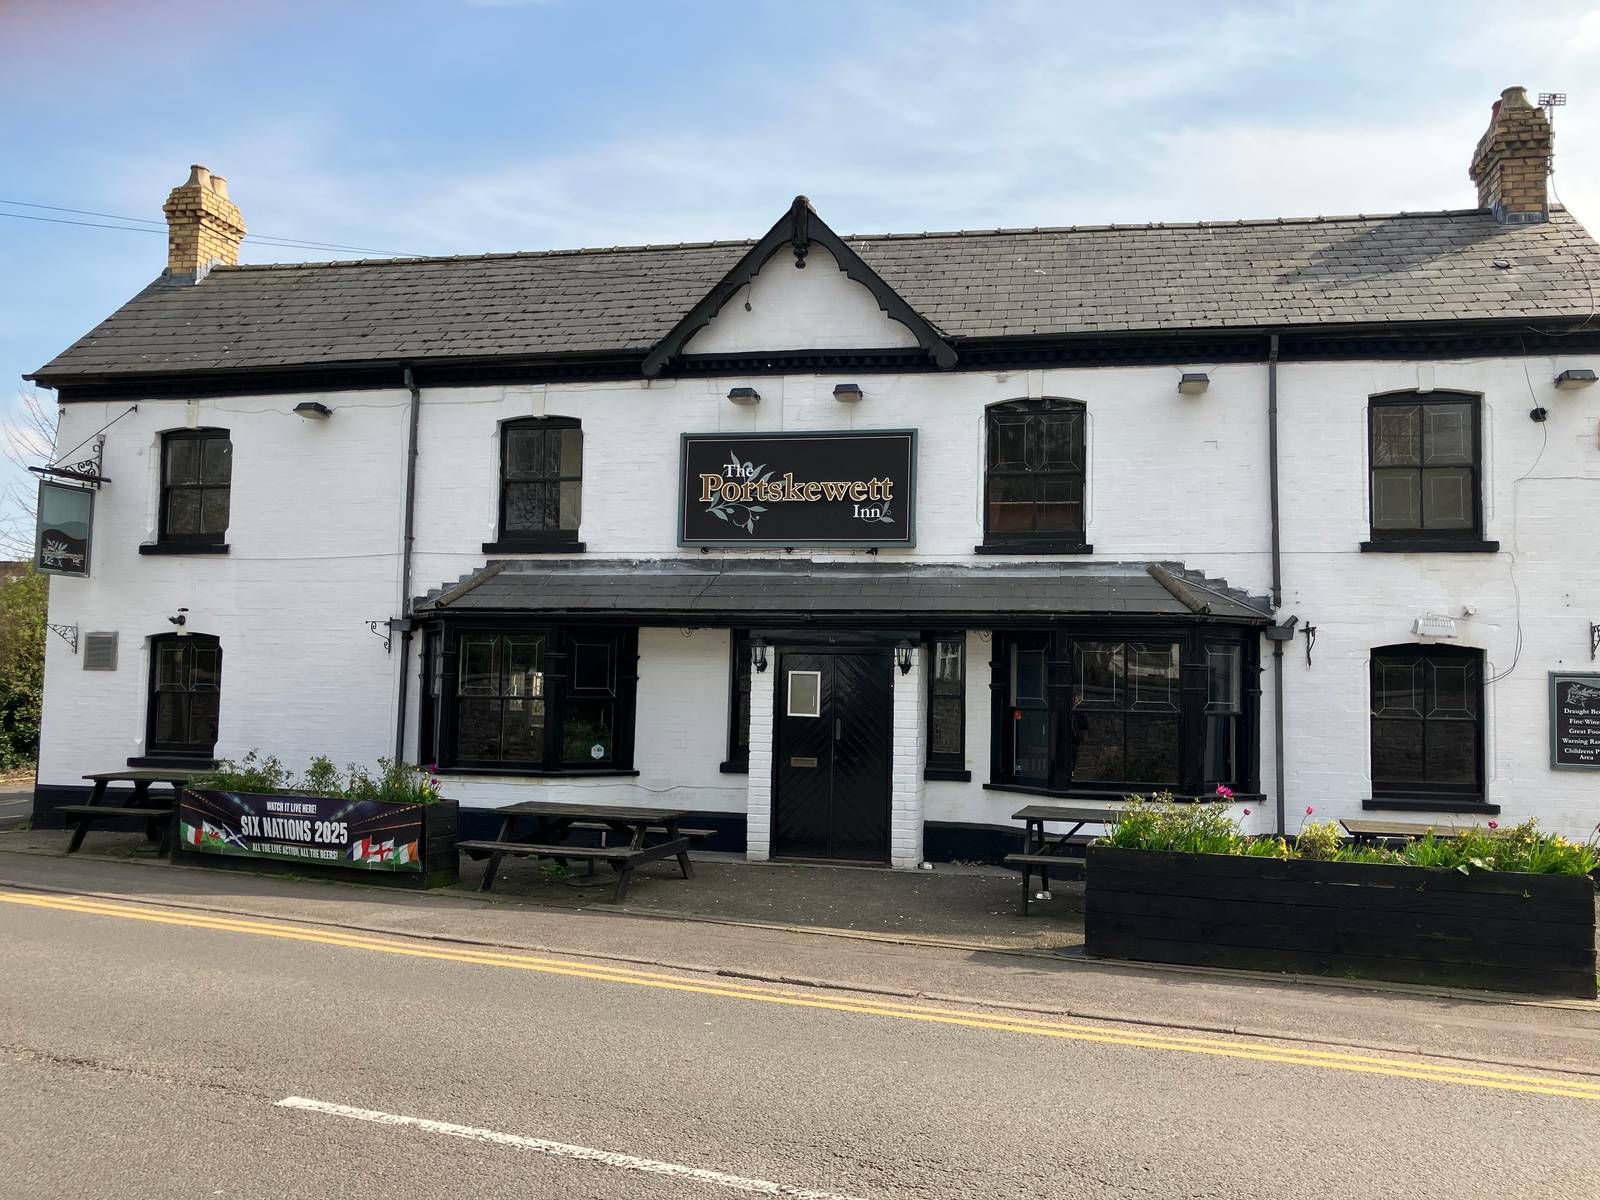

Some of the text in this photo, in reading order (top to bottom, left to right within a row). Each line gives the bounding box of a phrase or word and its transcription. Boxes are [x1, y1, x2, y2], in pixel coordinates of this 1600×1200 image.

[723, 464, 754, 477] The
[699, 472, 893, 502] Portskewett
[852, 504, 880, 518] Inn
[1564, 708, 1589, 716] Draught
[1562, 737, 1588, 745] Warning
[267, 801, 316, 814] WATCH IT LIVE HERE!
[241, 815, 347, 844] SIX NATIONS 2025
[261, 843, 271, 852] THE
[272, 844, 282, 853] LIVE
[300, 847, 310, 857] ALL
[310, 849, 320, 858] THE
[320, 849, 338, 860] BEERS!
